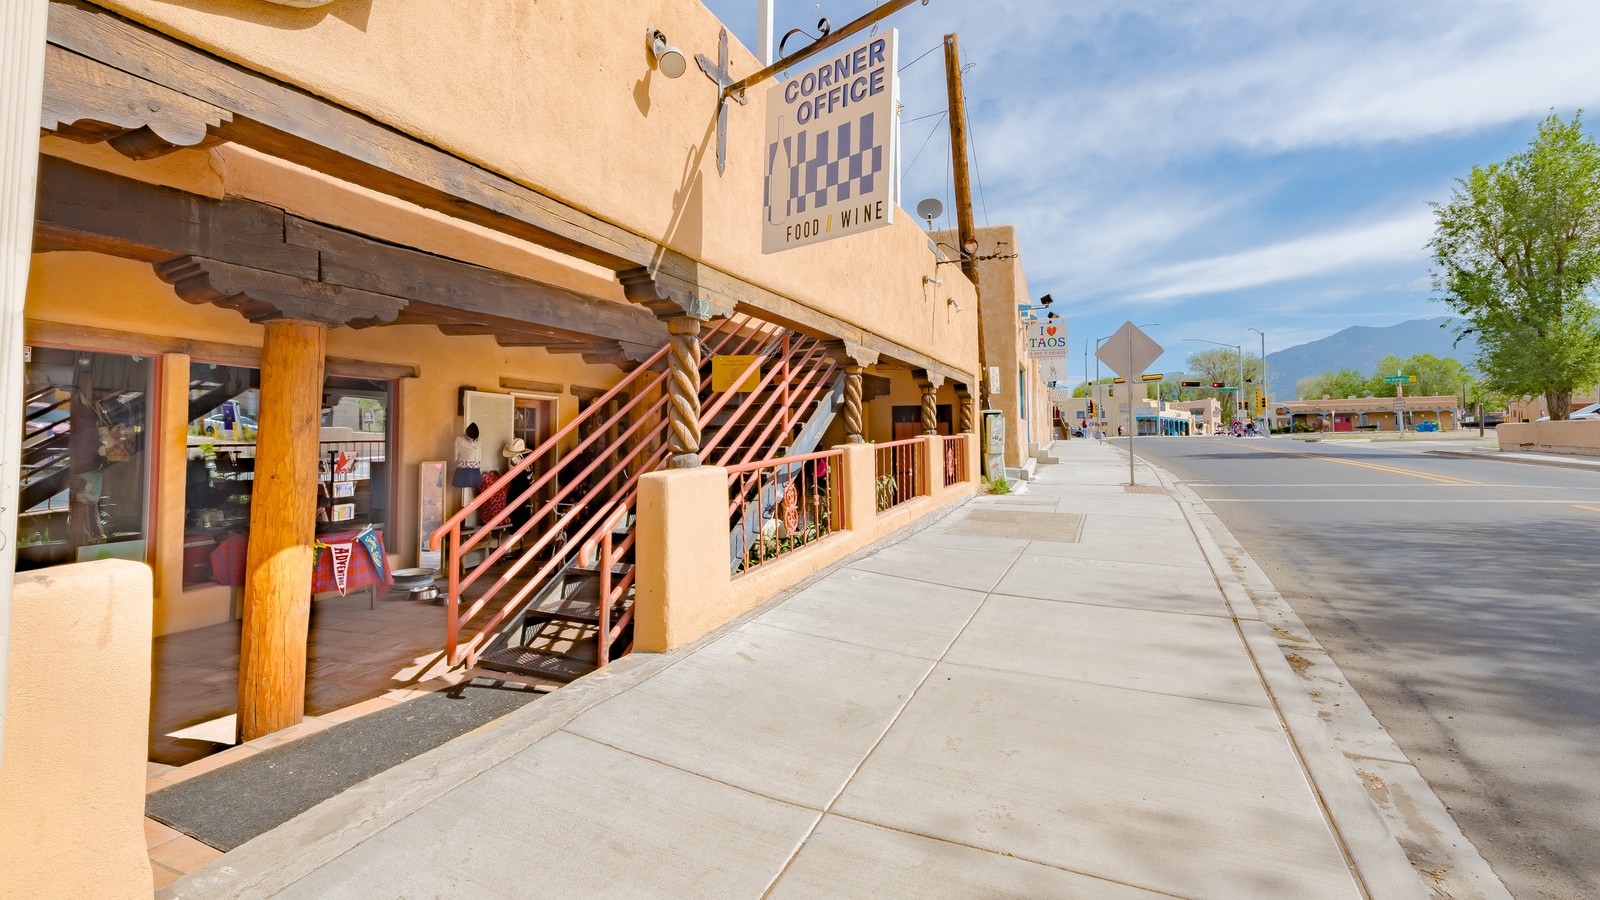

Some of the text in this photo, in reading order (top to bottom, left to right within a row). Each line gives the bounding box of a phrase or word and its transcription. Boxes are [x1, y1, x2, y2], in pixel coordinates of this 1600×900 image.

[784, 38, 886, 104] CORNER
[796, 66, 885, 125] OFFICE
[786, 218, 819, 243] FOOD
[841, 200, 883, 228] WINE
[689, 296, 710, 318] 122
[1029, 337, 1066, 348] TAOS
[1040, 326, 1044, 336] I
[334, 547, 350, 586] ADVENTURE
